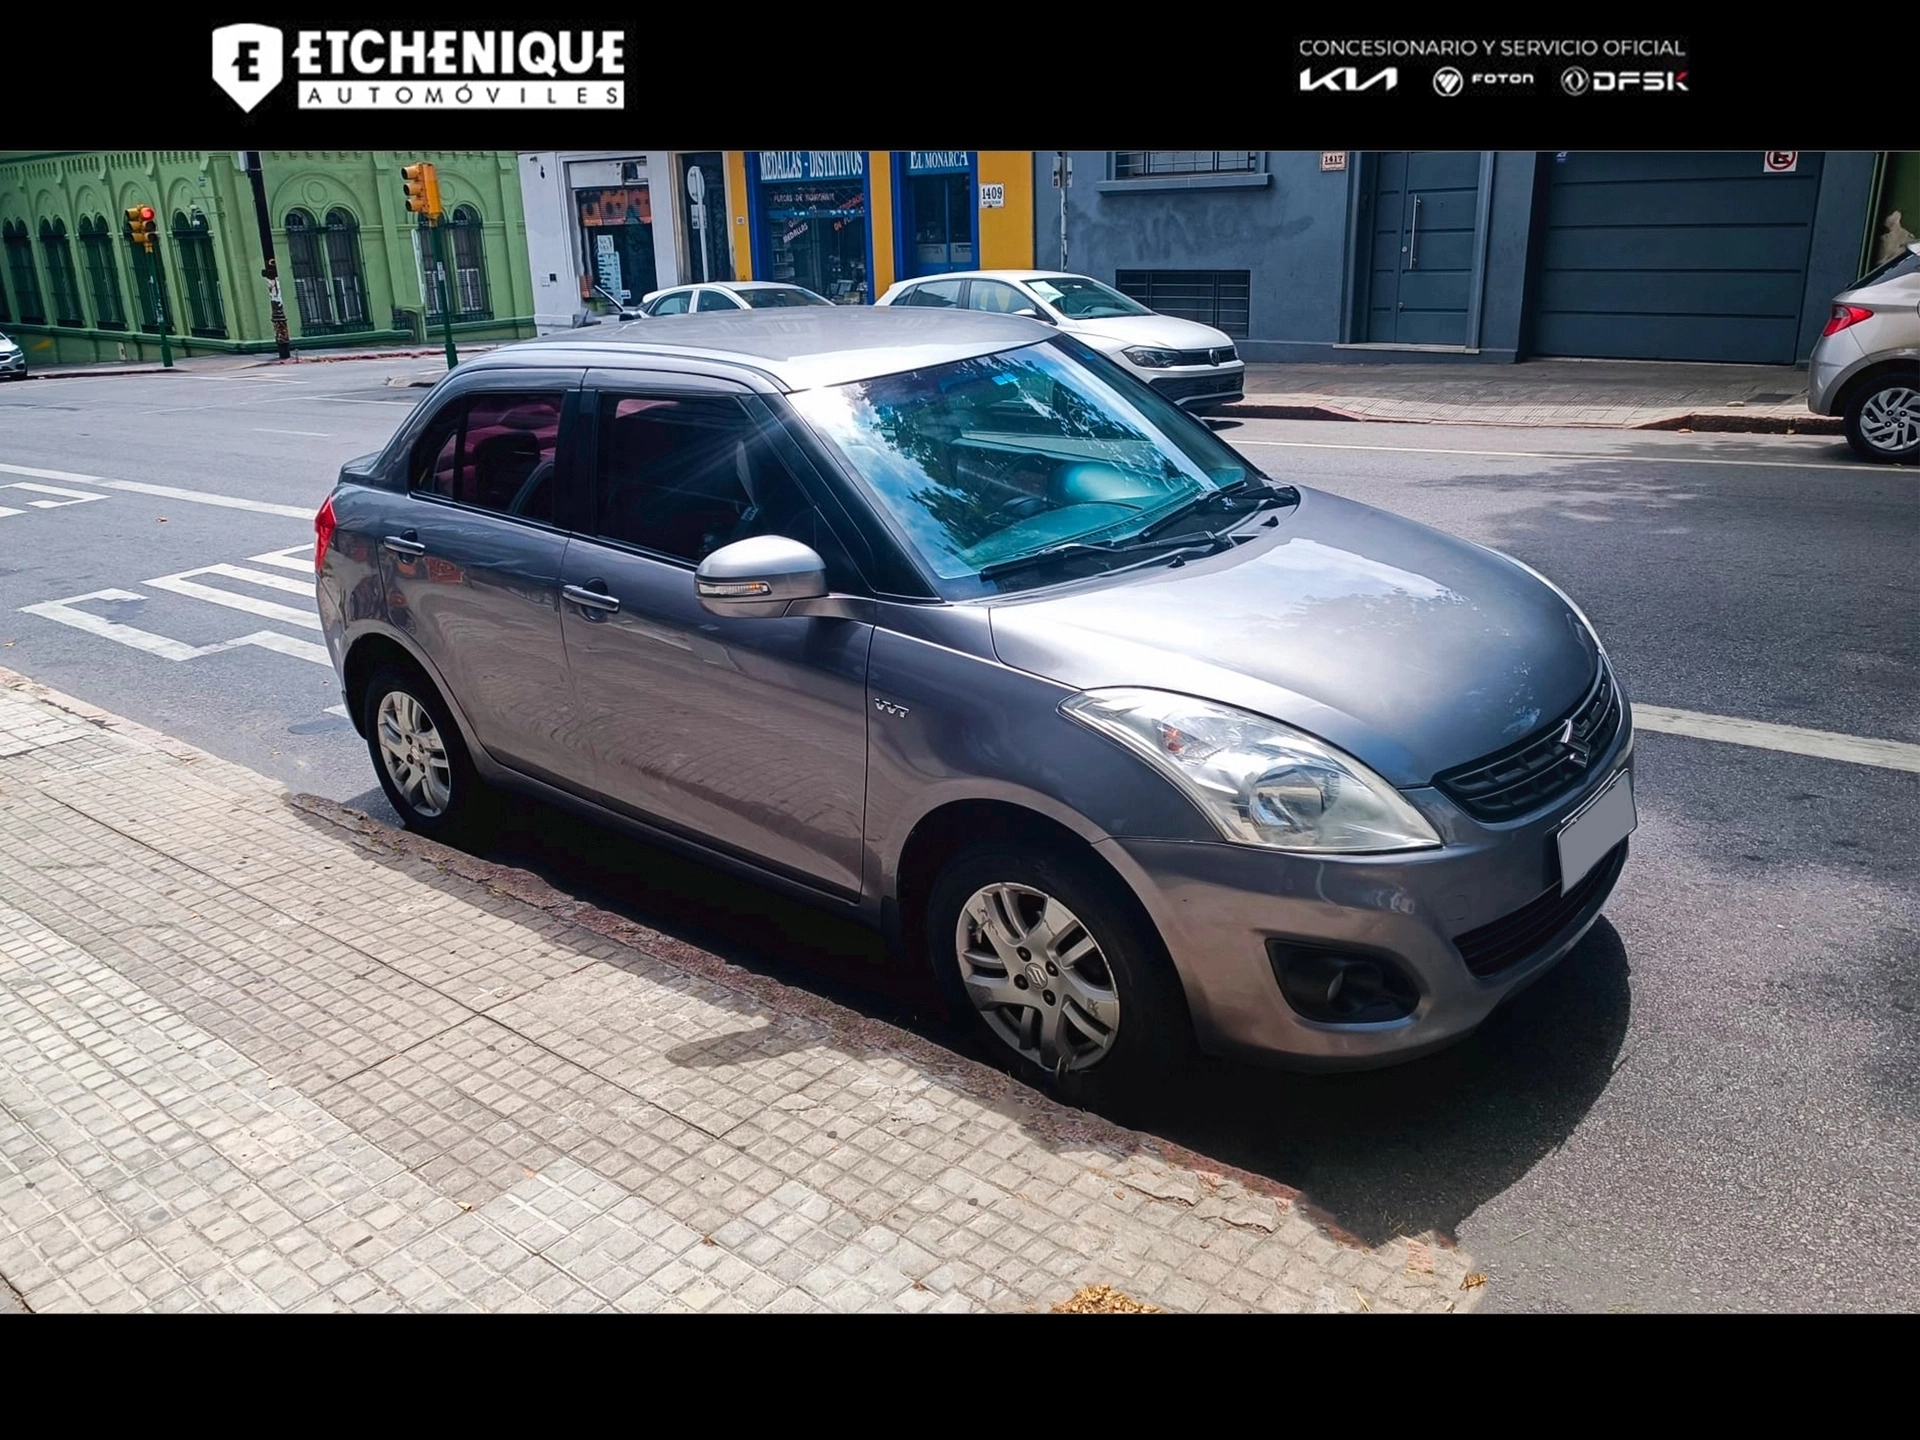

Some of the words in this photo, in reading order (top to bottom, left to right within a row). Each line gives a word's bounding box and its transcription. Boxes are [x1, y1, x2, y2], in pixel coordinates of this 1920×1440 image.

[760, 152, 802, 180] MEDALLAS
[809, 152, 863, 177] DISTINTIVOS
[925, 151, 969, 168] MONARCA
[1324, 155, 1343, 163] 1417
[982, 187, 1002, 200] 1409
